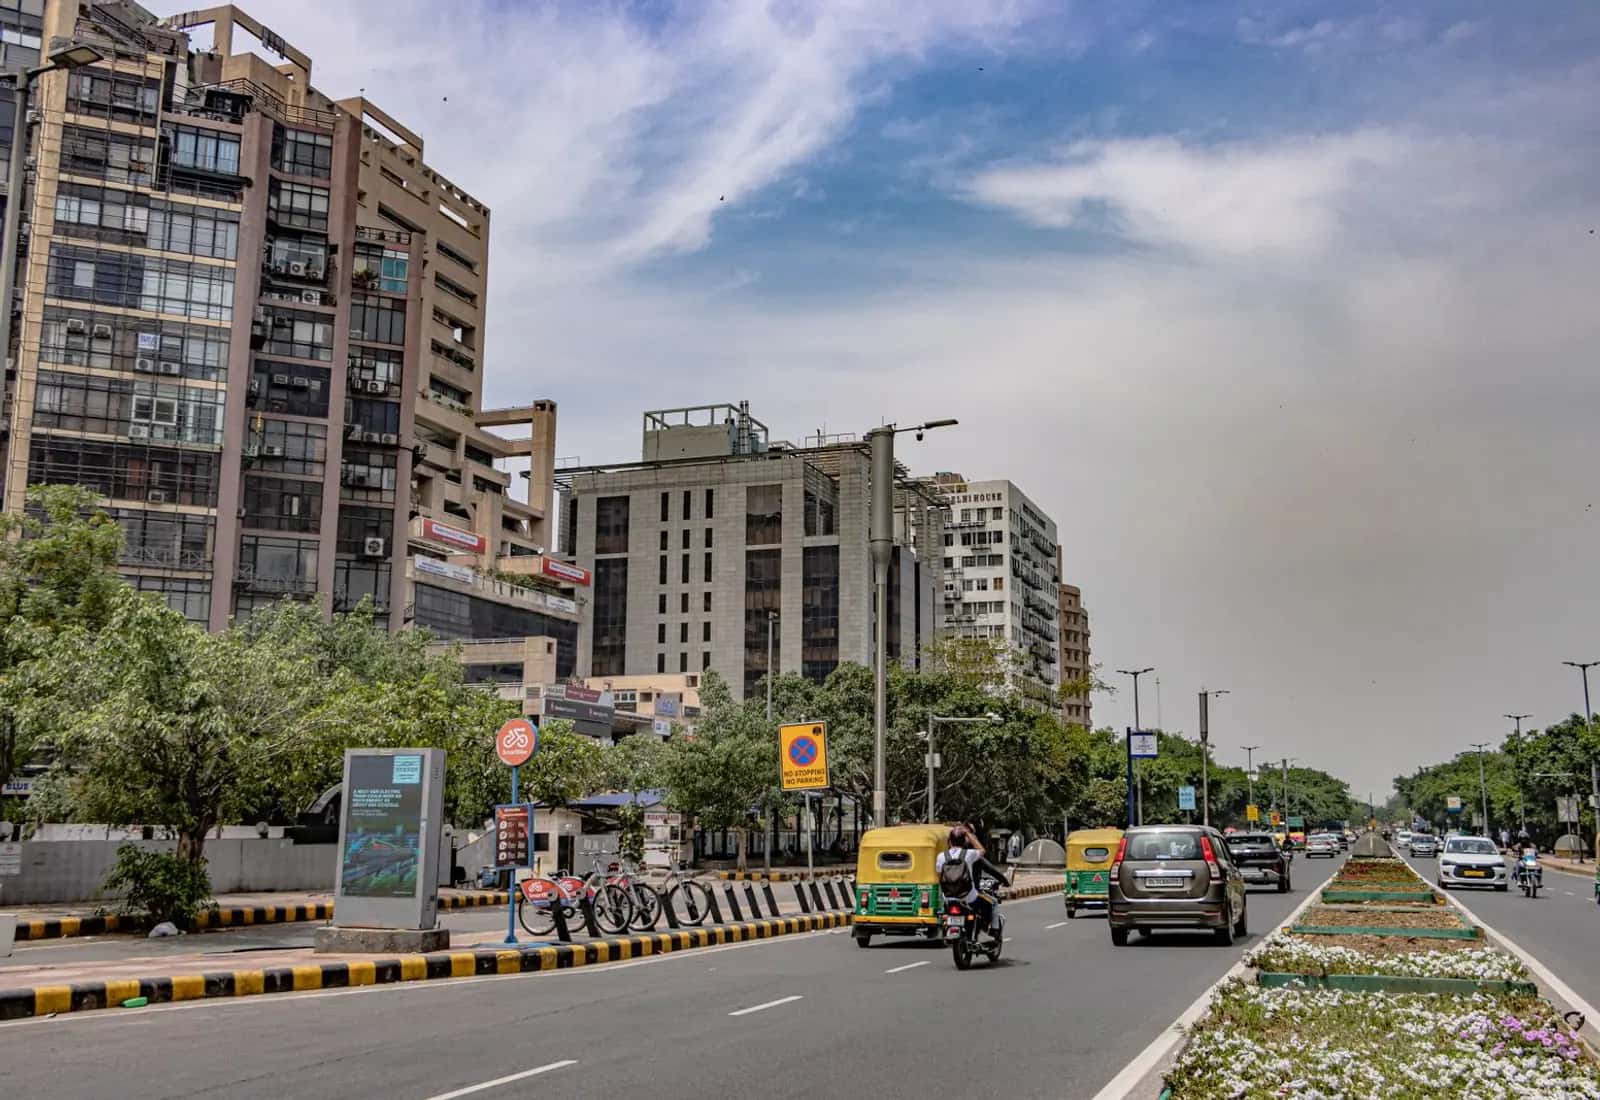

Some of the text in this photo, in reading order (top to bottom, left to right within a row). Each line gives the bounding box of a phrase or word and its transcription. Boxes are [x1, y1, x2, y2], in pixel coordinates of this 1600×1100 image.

[974, 493, 1002, 502] HOUSE
[795, 768, 825, 777] STOPPING
[796, 776, 824, 785] PARKING
